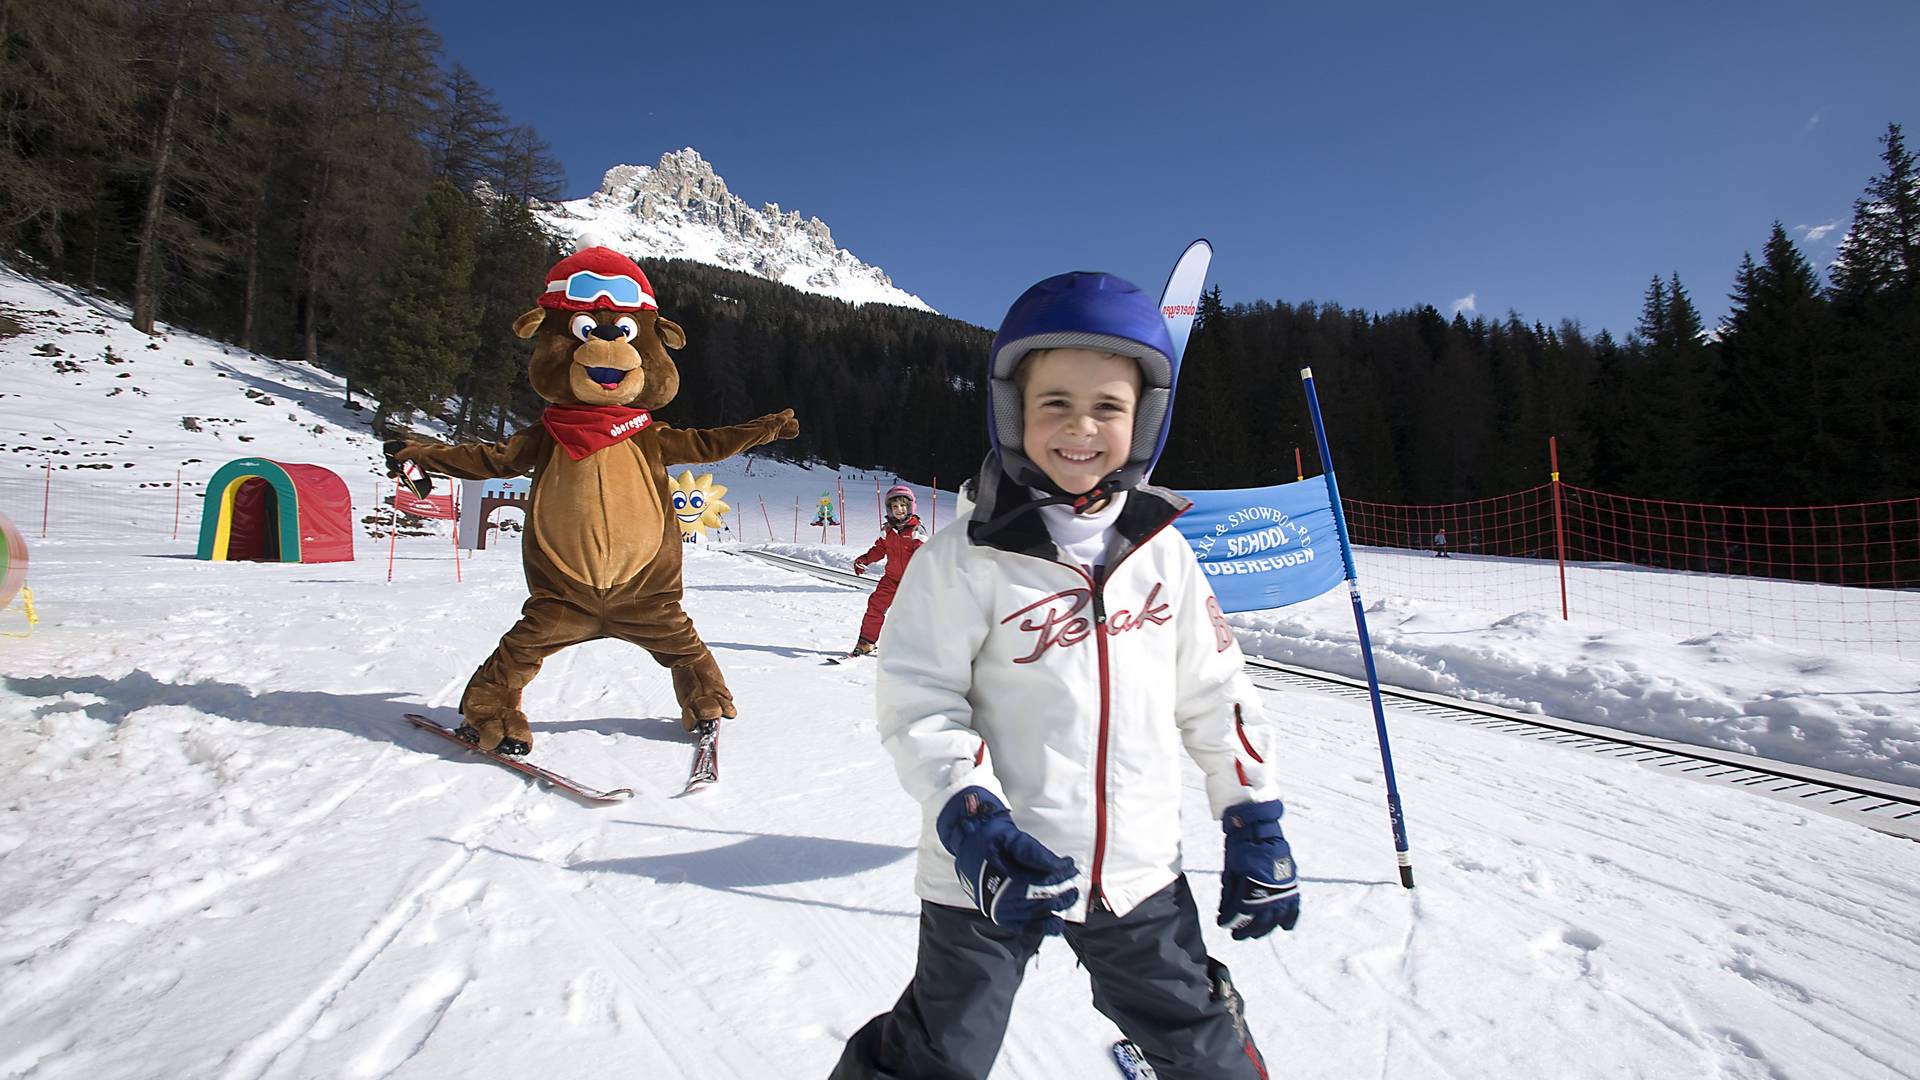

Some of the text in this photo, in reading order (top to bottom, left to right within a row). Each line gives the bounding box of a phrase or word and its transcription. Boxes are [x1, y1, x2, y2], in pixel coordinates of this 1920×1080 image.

[1195, 534, 1217, 560] SKI
[1215, 523, 1229, 537] &
[1227, 527, 1290, 558] SCHOOL
[1203, 548, 1315, 576] OBEREGGEN
[1000, 583, 1173, 664] Peak
